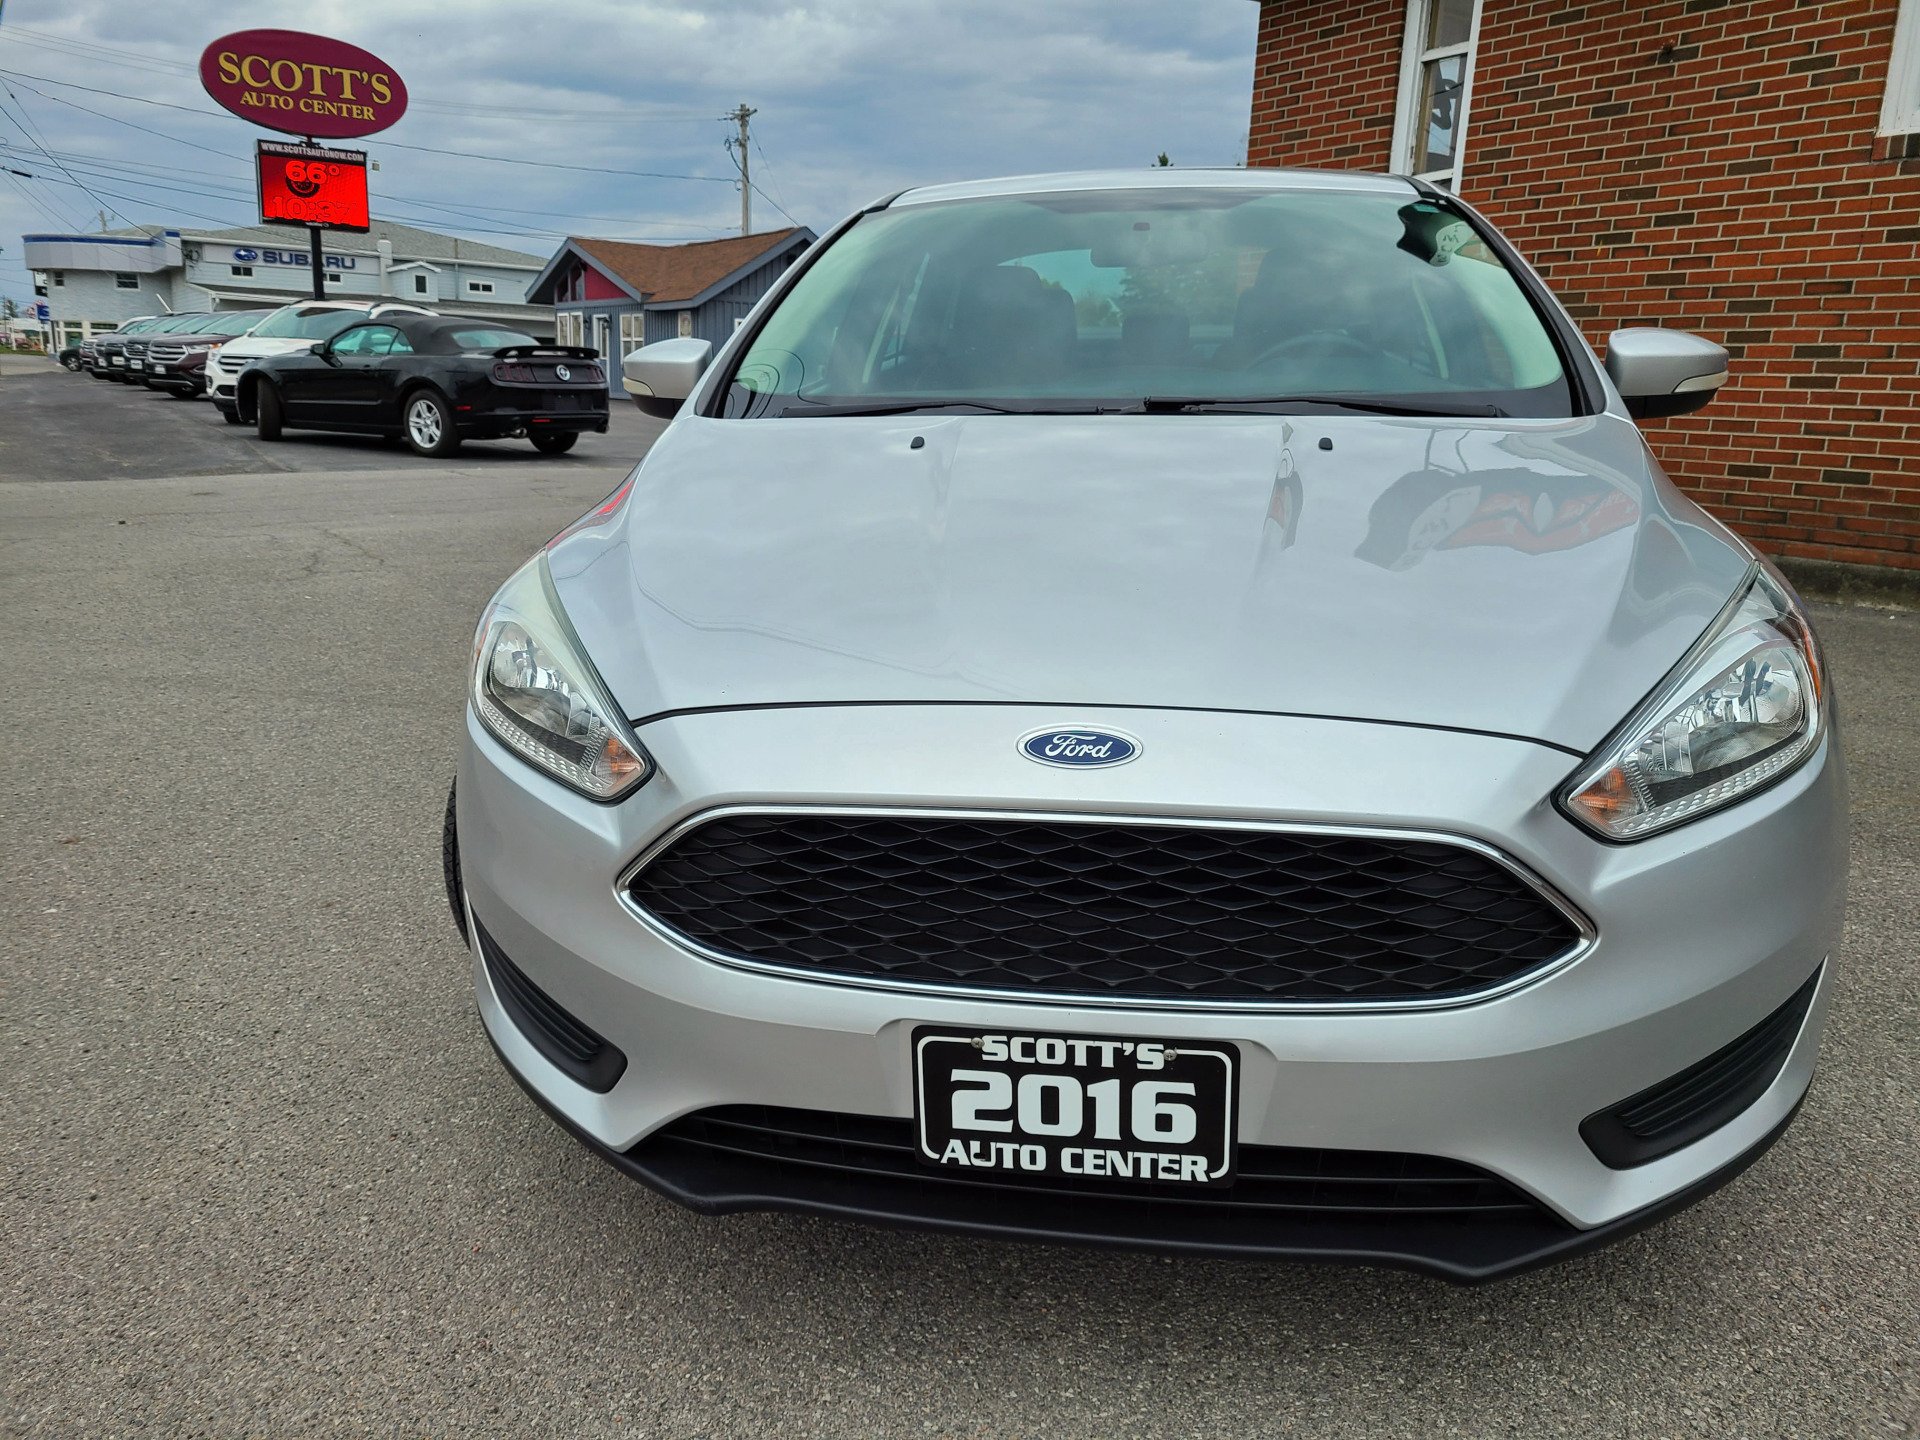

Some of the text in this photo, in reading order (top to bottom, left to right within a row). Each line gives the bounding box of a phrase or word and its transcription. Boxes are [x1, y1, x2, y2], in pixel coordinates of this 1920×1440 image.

[218, 52, 392, 104] SCOTT'S
[240, 91, 376, 121] AUTO CENTER
[260, 142, 364, 162] WWW.SCOTTSAUTONOW.COM
[1045, 734, 1113, 758] Ford
[981, 1035, 1165, 1070] SCOTT'S
[951, 1069, 1197, 1144] 2016
[940, 1139, 1209, 1182] AUTO CENTER
